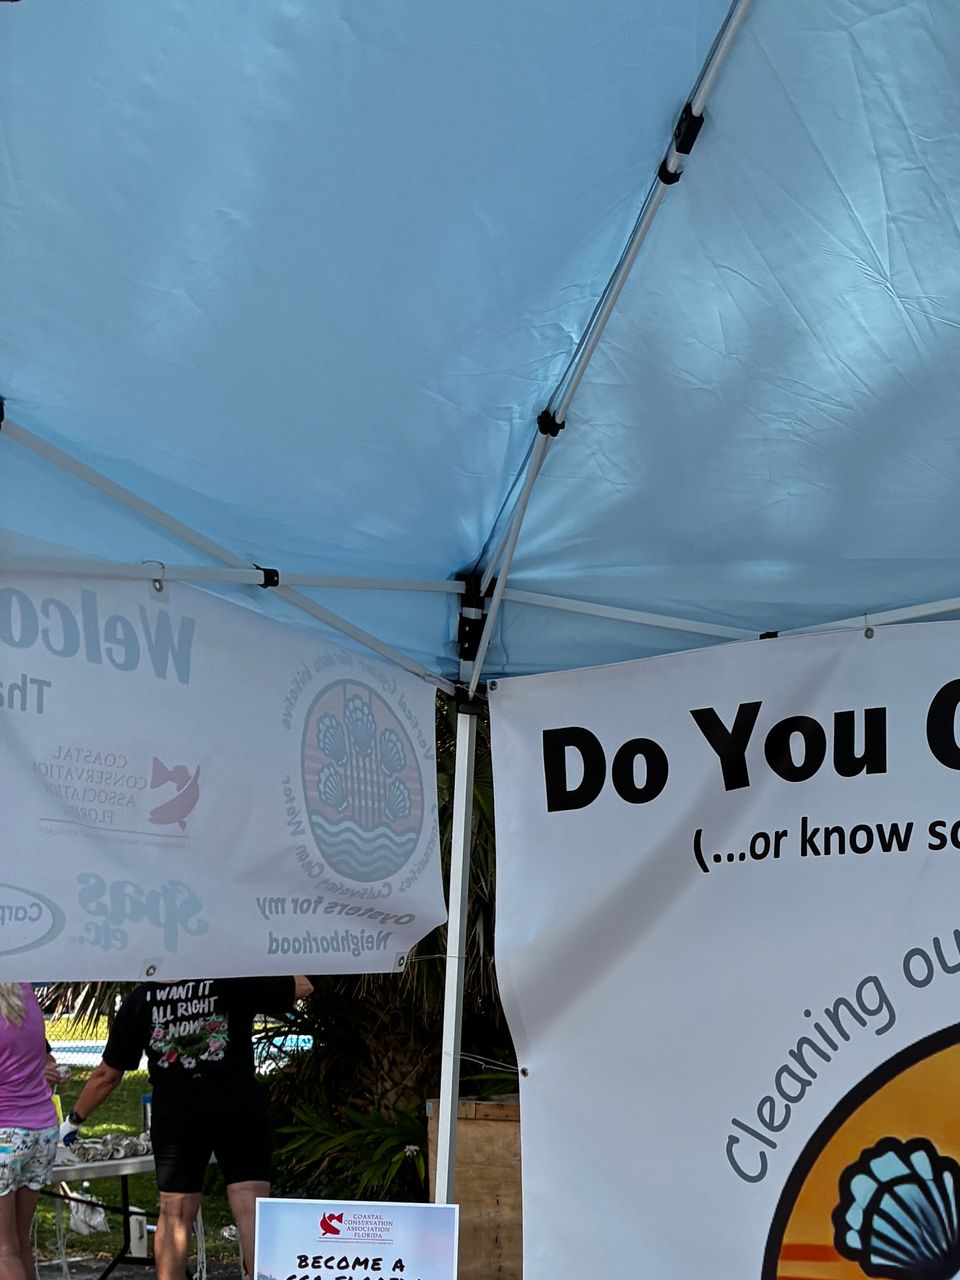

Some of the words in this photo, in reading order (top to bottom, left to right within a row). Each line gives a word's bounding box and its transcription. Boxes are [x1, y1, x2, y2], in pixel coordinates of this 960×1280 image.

[541, 724, 669, 813] Do
[689, 700, 888, 793] You
[692, 827, 789, 873] (...or
[798, 816, 914, 858] know
[156, 982, 196, 1002] WANT
[199, 980, 214, 996] IT
[152, 1005, 175, 1024] ALL
[177, 996, 219, 1018] RIGHT
[725, 974, 898, 1184] Cleaning
[343, 1219, 394, 1228] CONSERVATION
[353, 1213, 384, 1221] COASTAL
[346, 1226, 391, 1234] ASSOCIATION
[296, 1254, 384, 1272] BECOME
[391, 1258, 406, 1273] A
